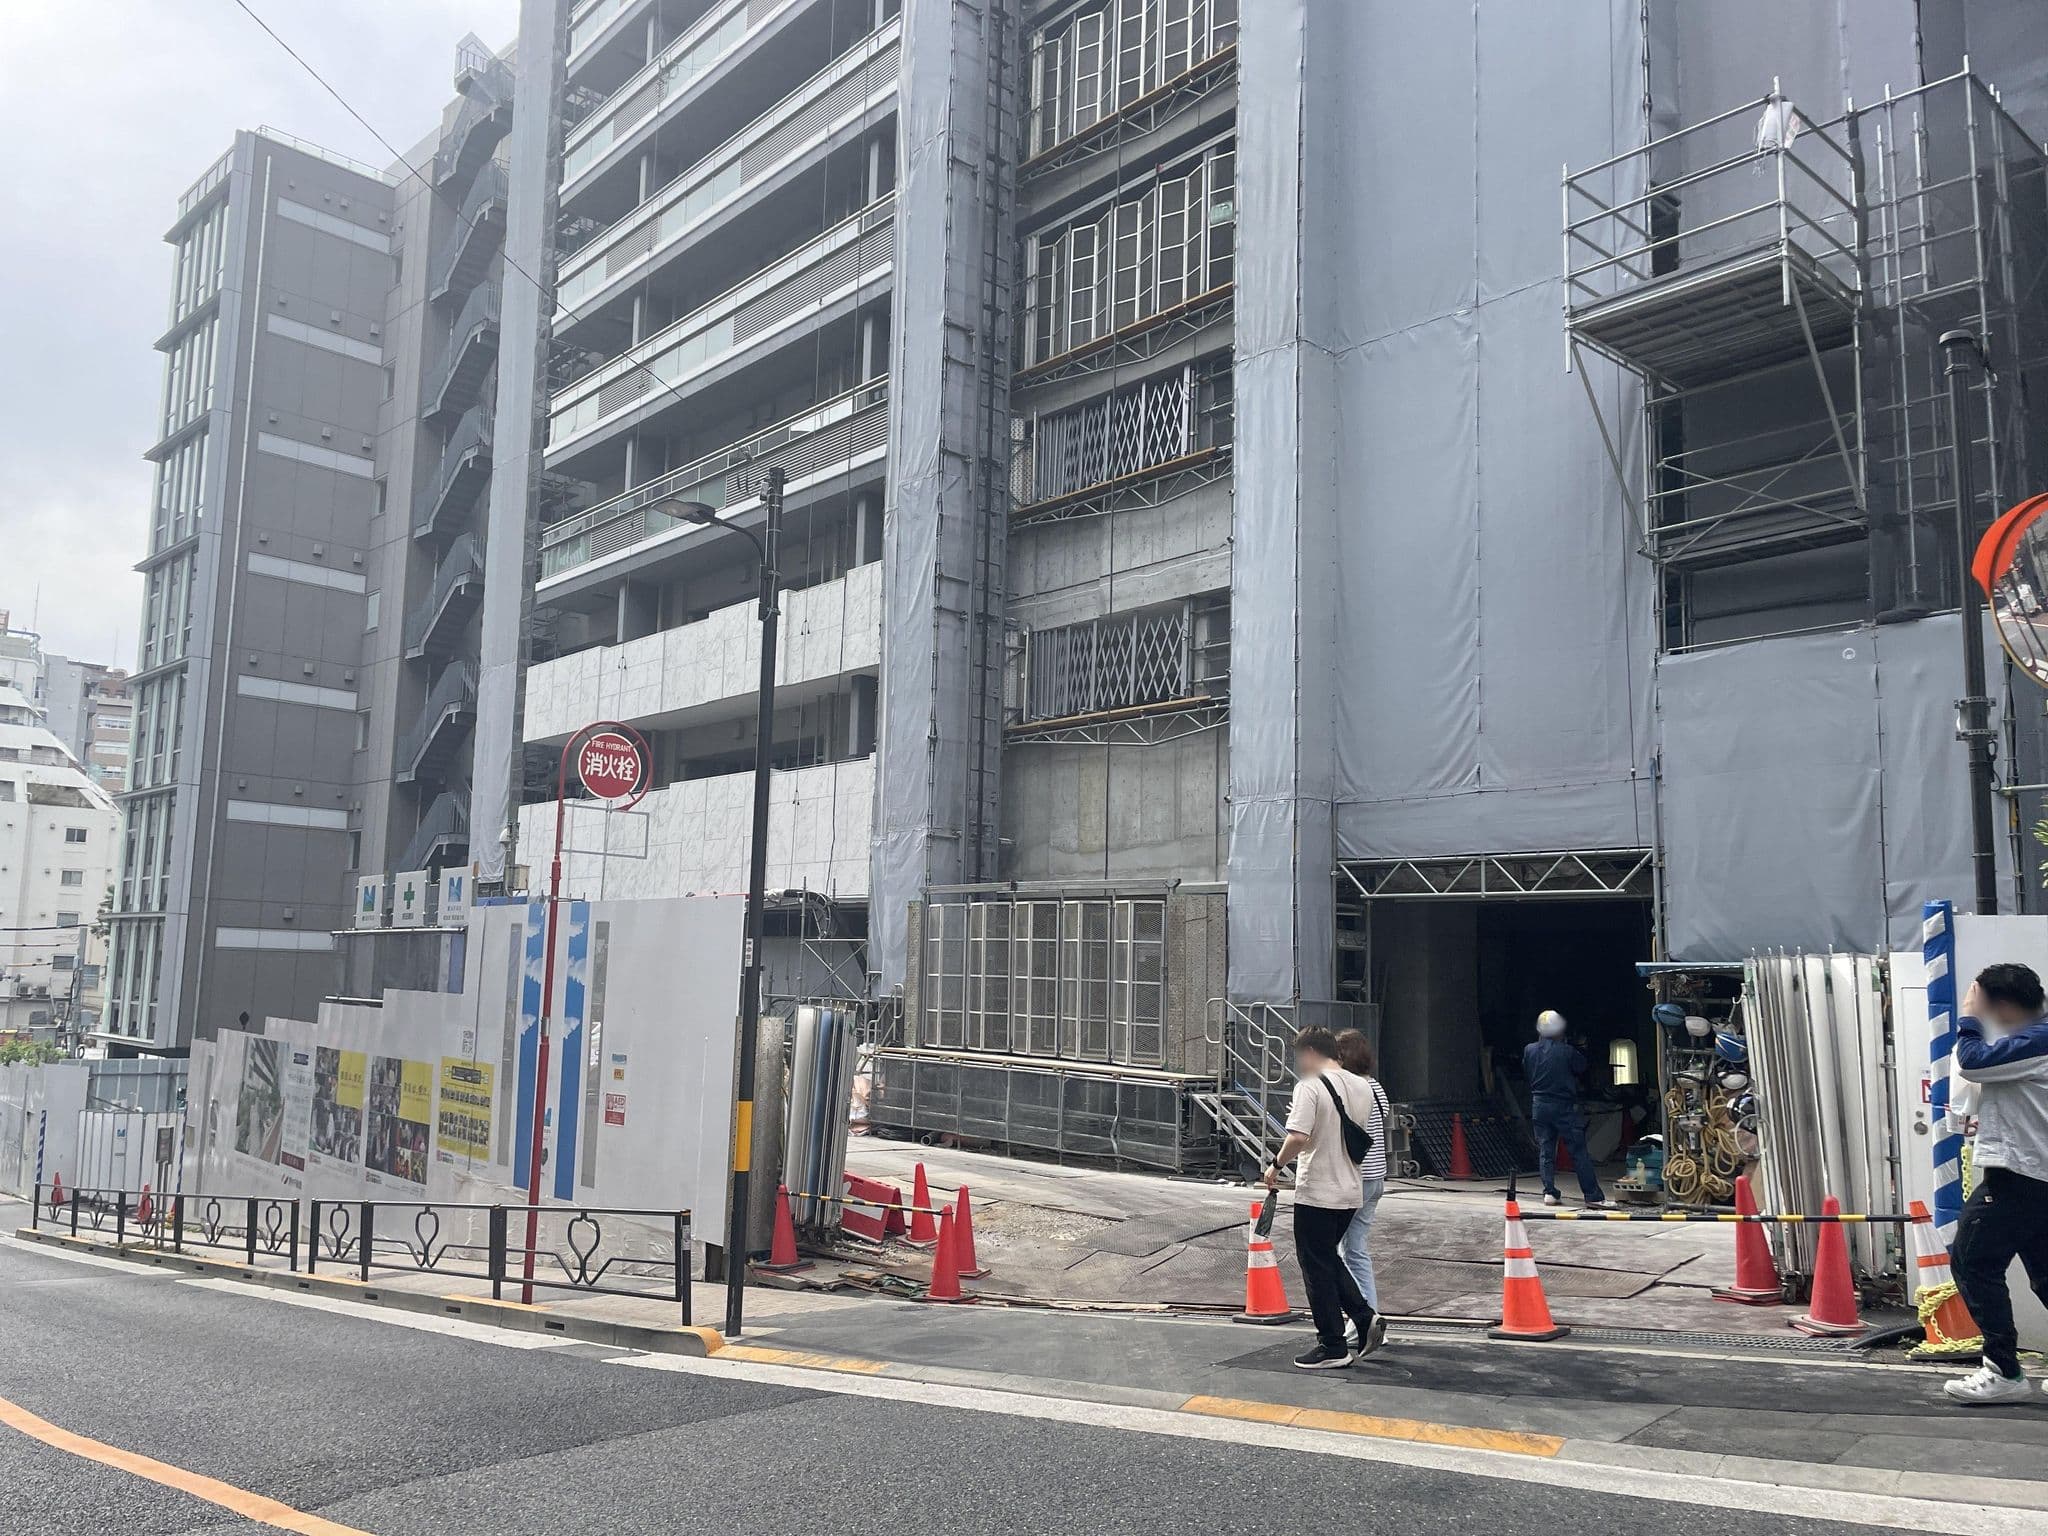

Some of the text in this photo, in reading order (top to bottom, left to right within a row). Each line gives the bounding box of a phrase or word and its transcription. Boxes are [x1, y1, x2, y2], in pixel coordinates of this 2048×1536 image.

[592, 741, 631, 752] FIRE HYDRANT
[585, 752, 635, 781] 消火栓
